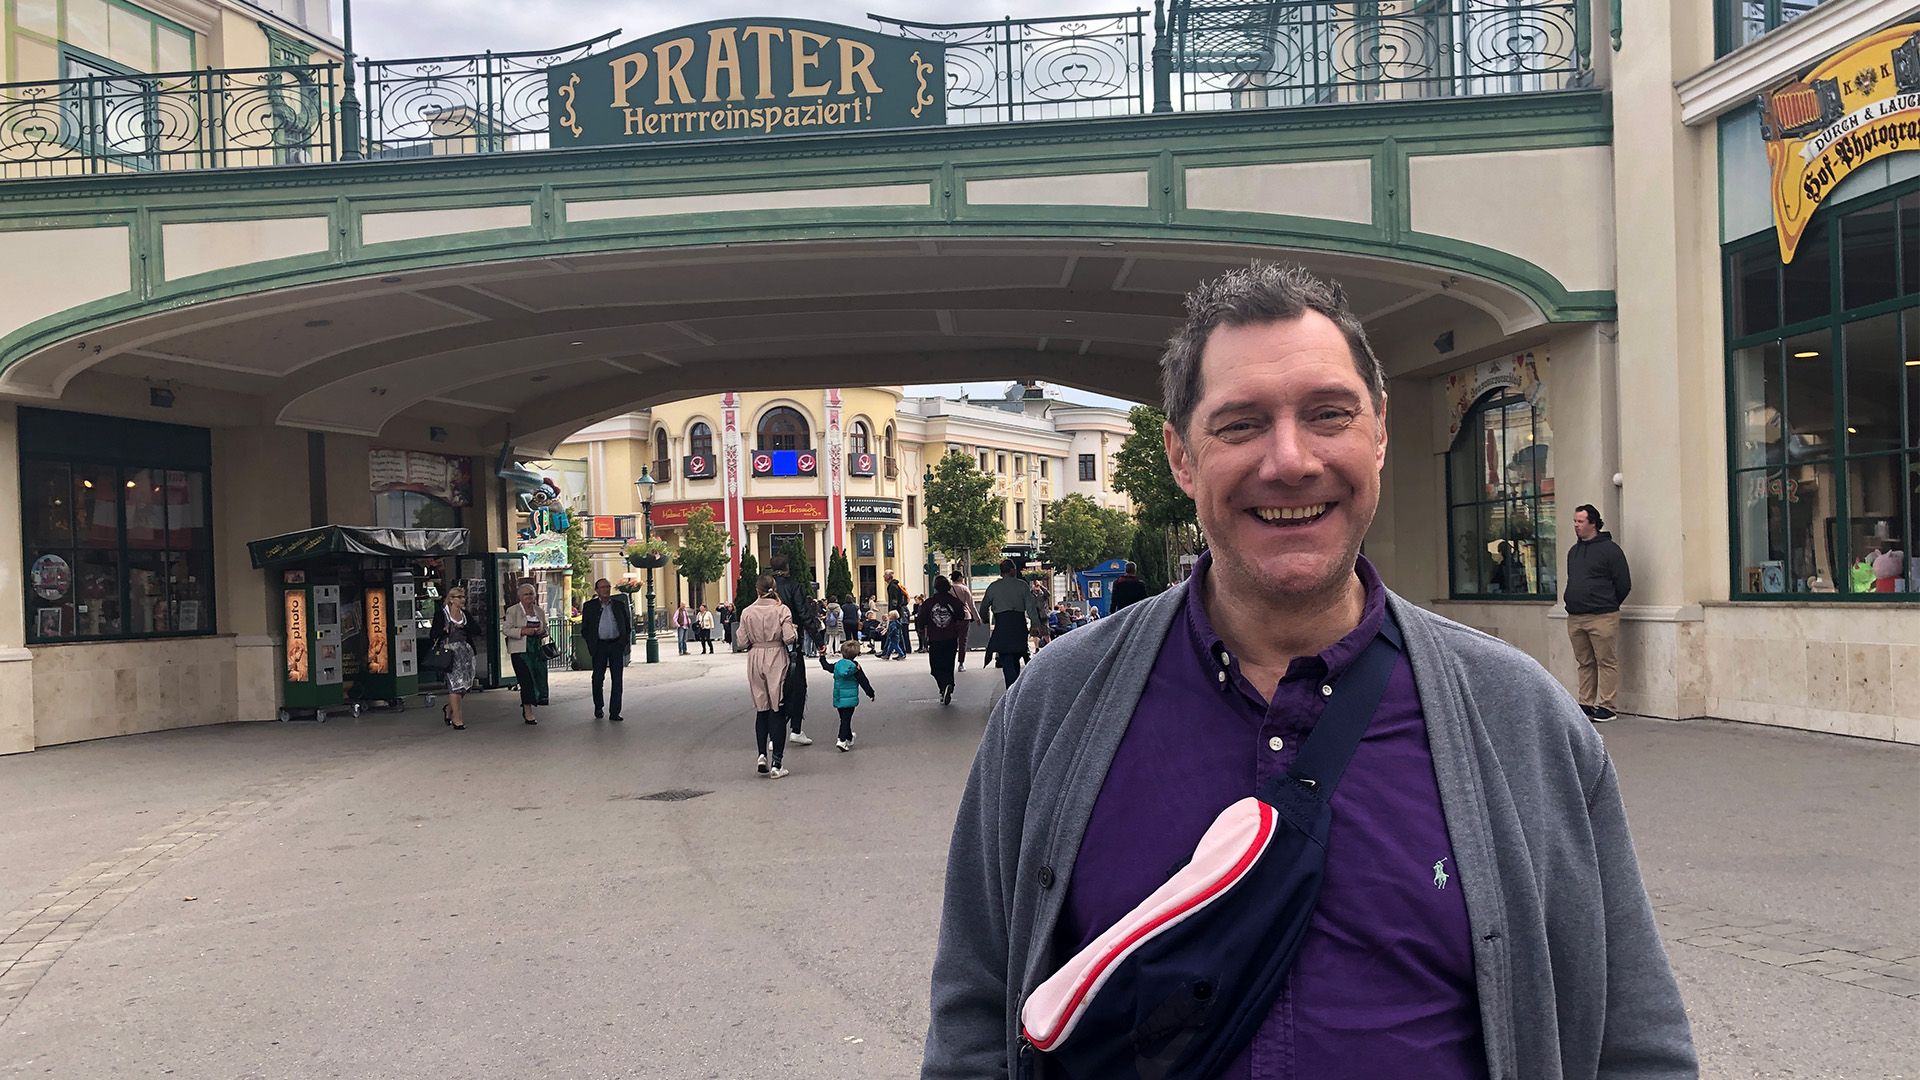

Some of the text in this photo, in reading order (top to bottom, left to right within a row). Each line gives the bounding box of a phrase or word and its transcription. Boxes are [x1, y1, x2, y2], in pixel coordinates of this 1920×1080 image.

[608, 25, 883, 108] PRATER
[1842, 63, 1892, 96] K K
[623, 96, 872, 135] Herrrreinspaziert!
[1814, 114, 1859, 151] DURCH
[1864, 107, 1875, 121] &
[756, 503, 787, 515] Madame
[872, 506, 892, 514] WORLD
[291, 599, 302, 640] photo
[371, 596, 382, 634] photo
